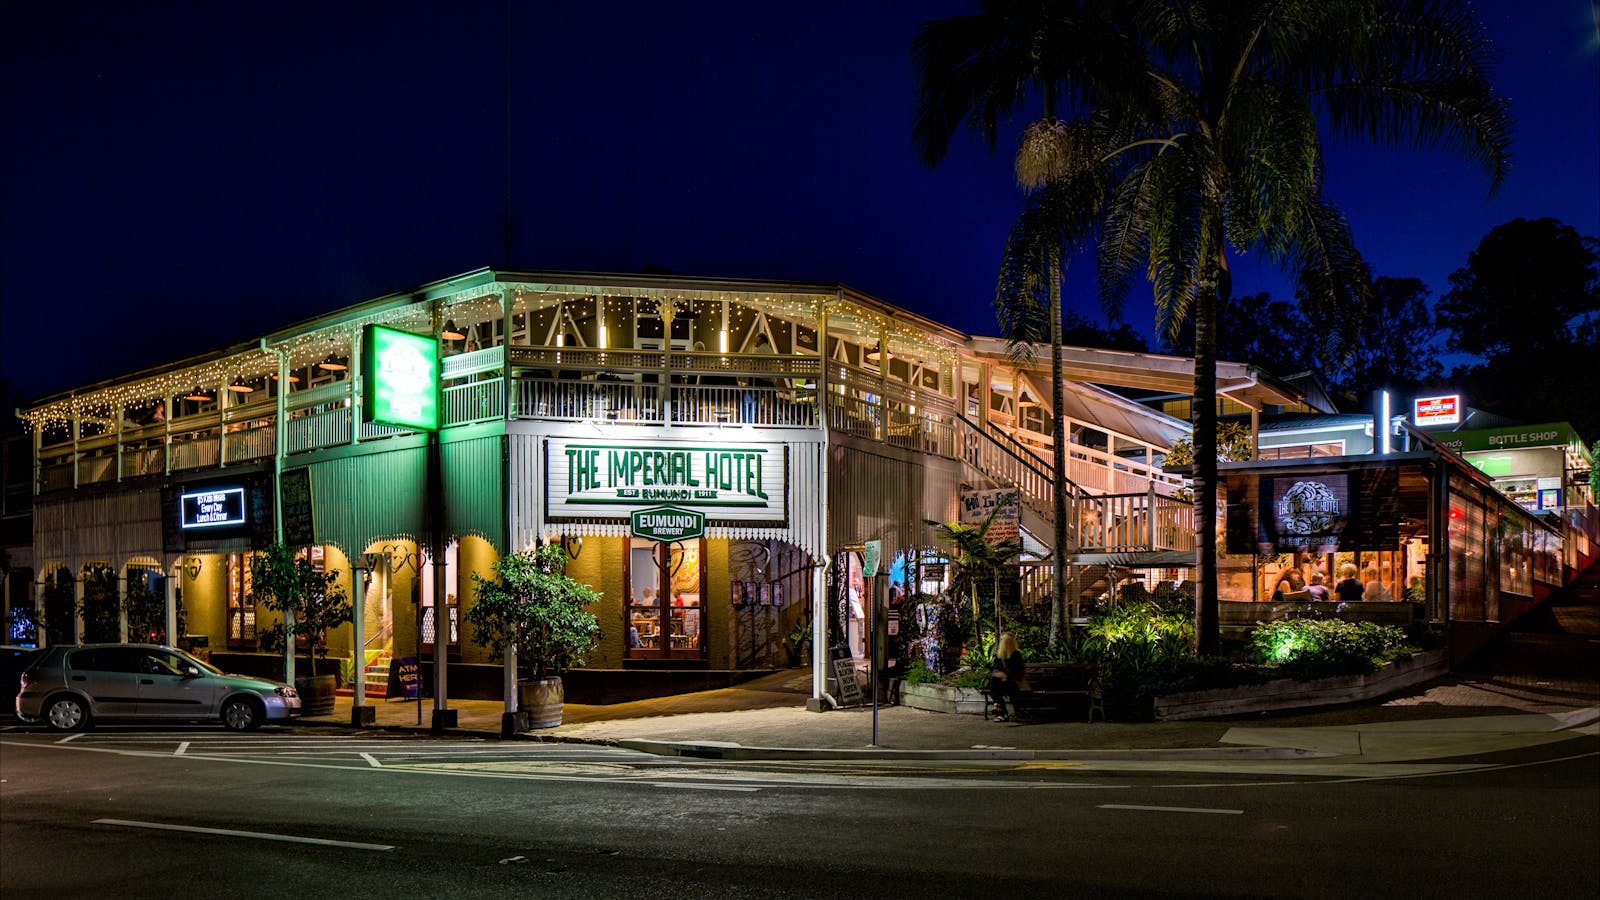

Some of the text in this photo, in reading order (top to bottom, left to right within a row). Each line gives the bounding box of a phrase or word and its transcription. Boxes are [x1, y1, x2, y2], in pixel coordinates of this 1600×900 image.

[1489, 431, 1558, 445] BOTTLE SHOP
[565, 449, 768, 500] THE IMPERIAL HOTEL
[642, 488, 691, 499] EUMUNDI
[201, 503, 223, 513] Every Day
[1278, 501, 1289, 516] THE
[1320, 500, 1340, 514] HOTEL
[197, 513, 210, 522] Lunch
[640, 515, 697, 529] EUMUNDI
[653, 527, 683, 535] BREWERY
[399, 665, 418, 673] ATM
[399, 674, 418, 682] HER
